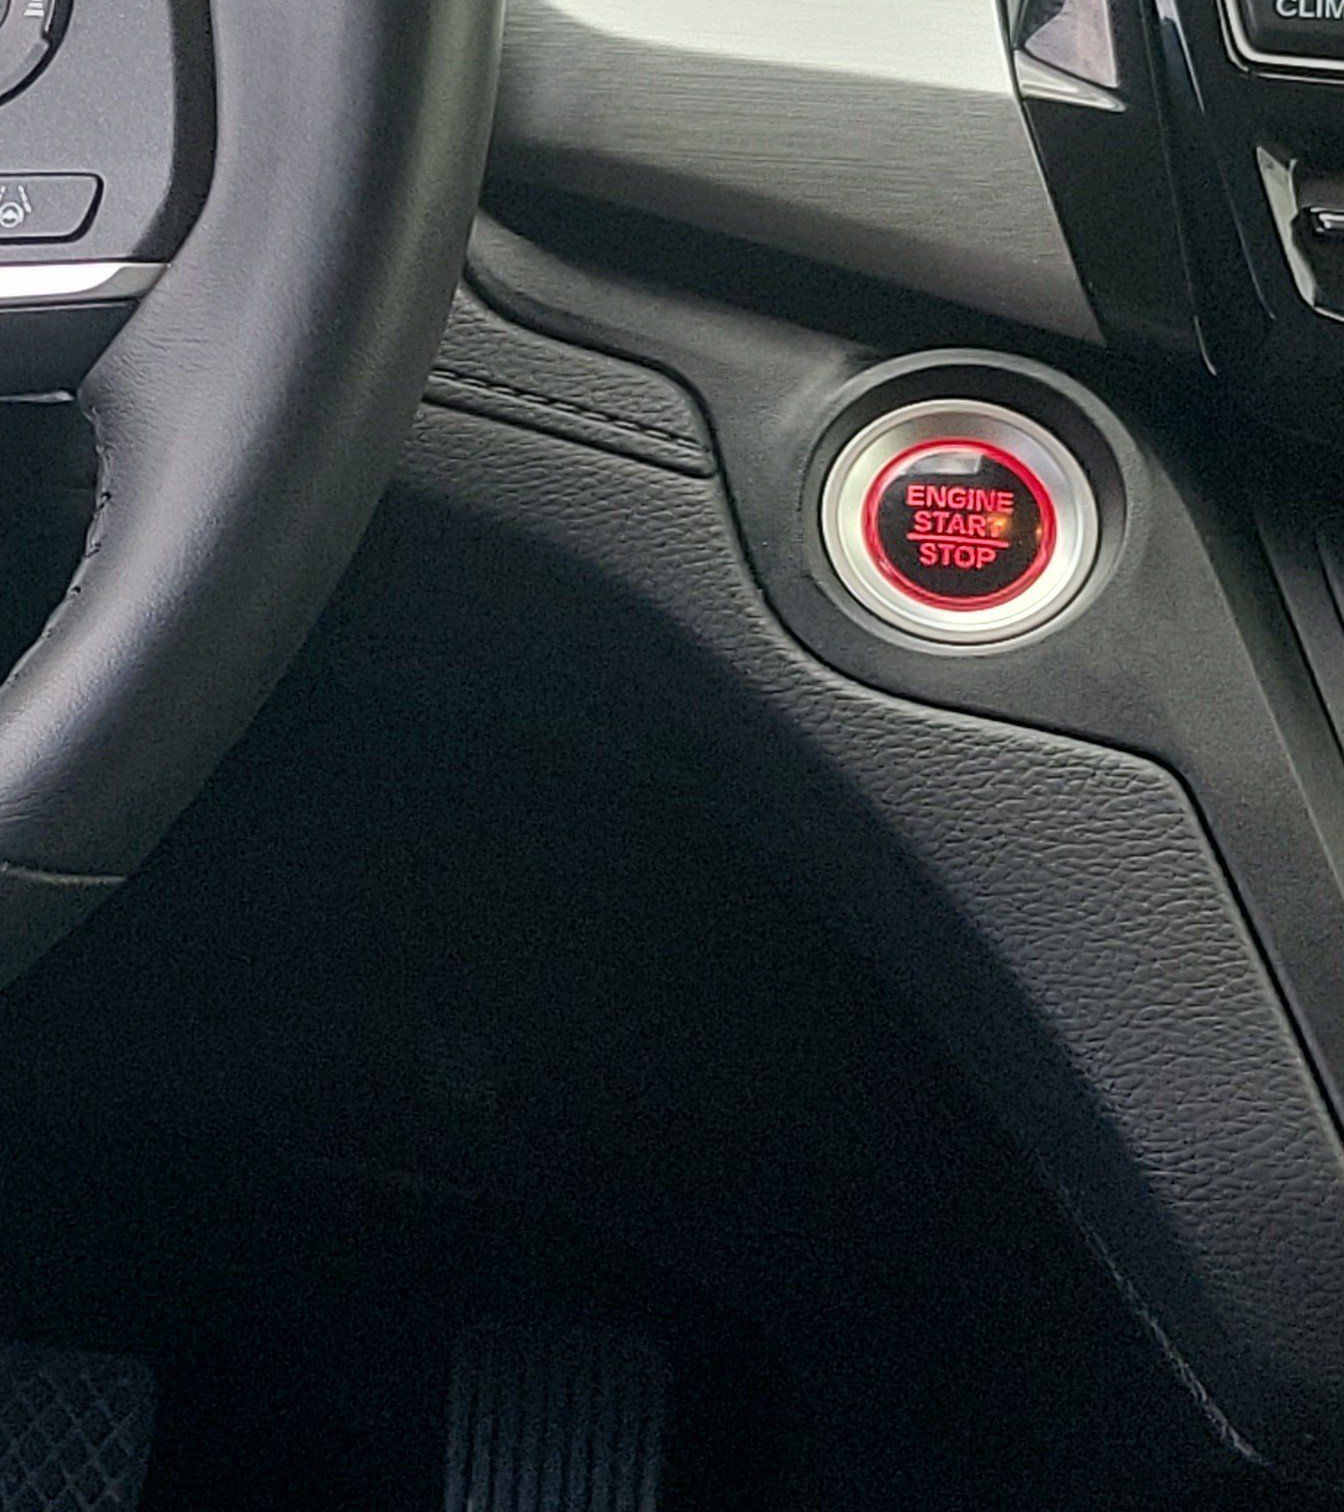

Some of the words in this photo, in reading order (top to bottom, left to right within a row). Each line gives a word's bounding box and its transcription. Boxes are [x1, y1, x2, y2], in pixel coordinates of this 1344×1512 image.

[906, 485, 1014, 513] ENGINE
[914, 511, 1006, 538] START
[919, 543, 997, 568] STOP
